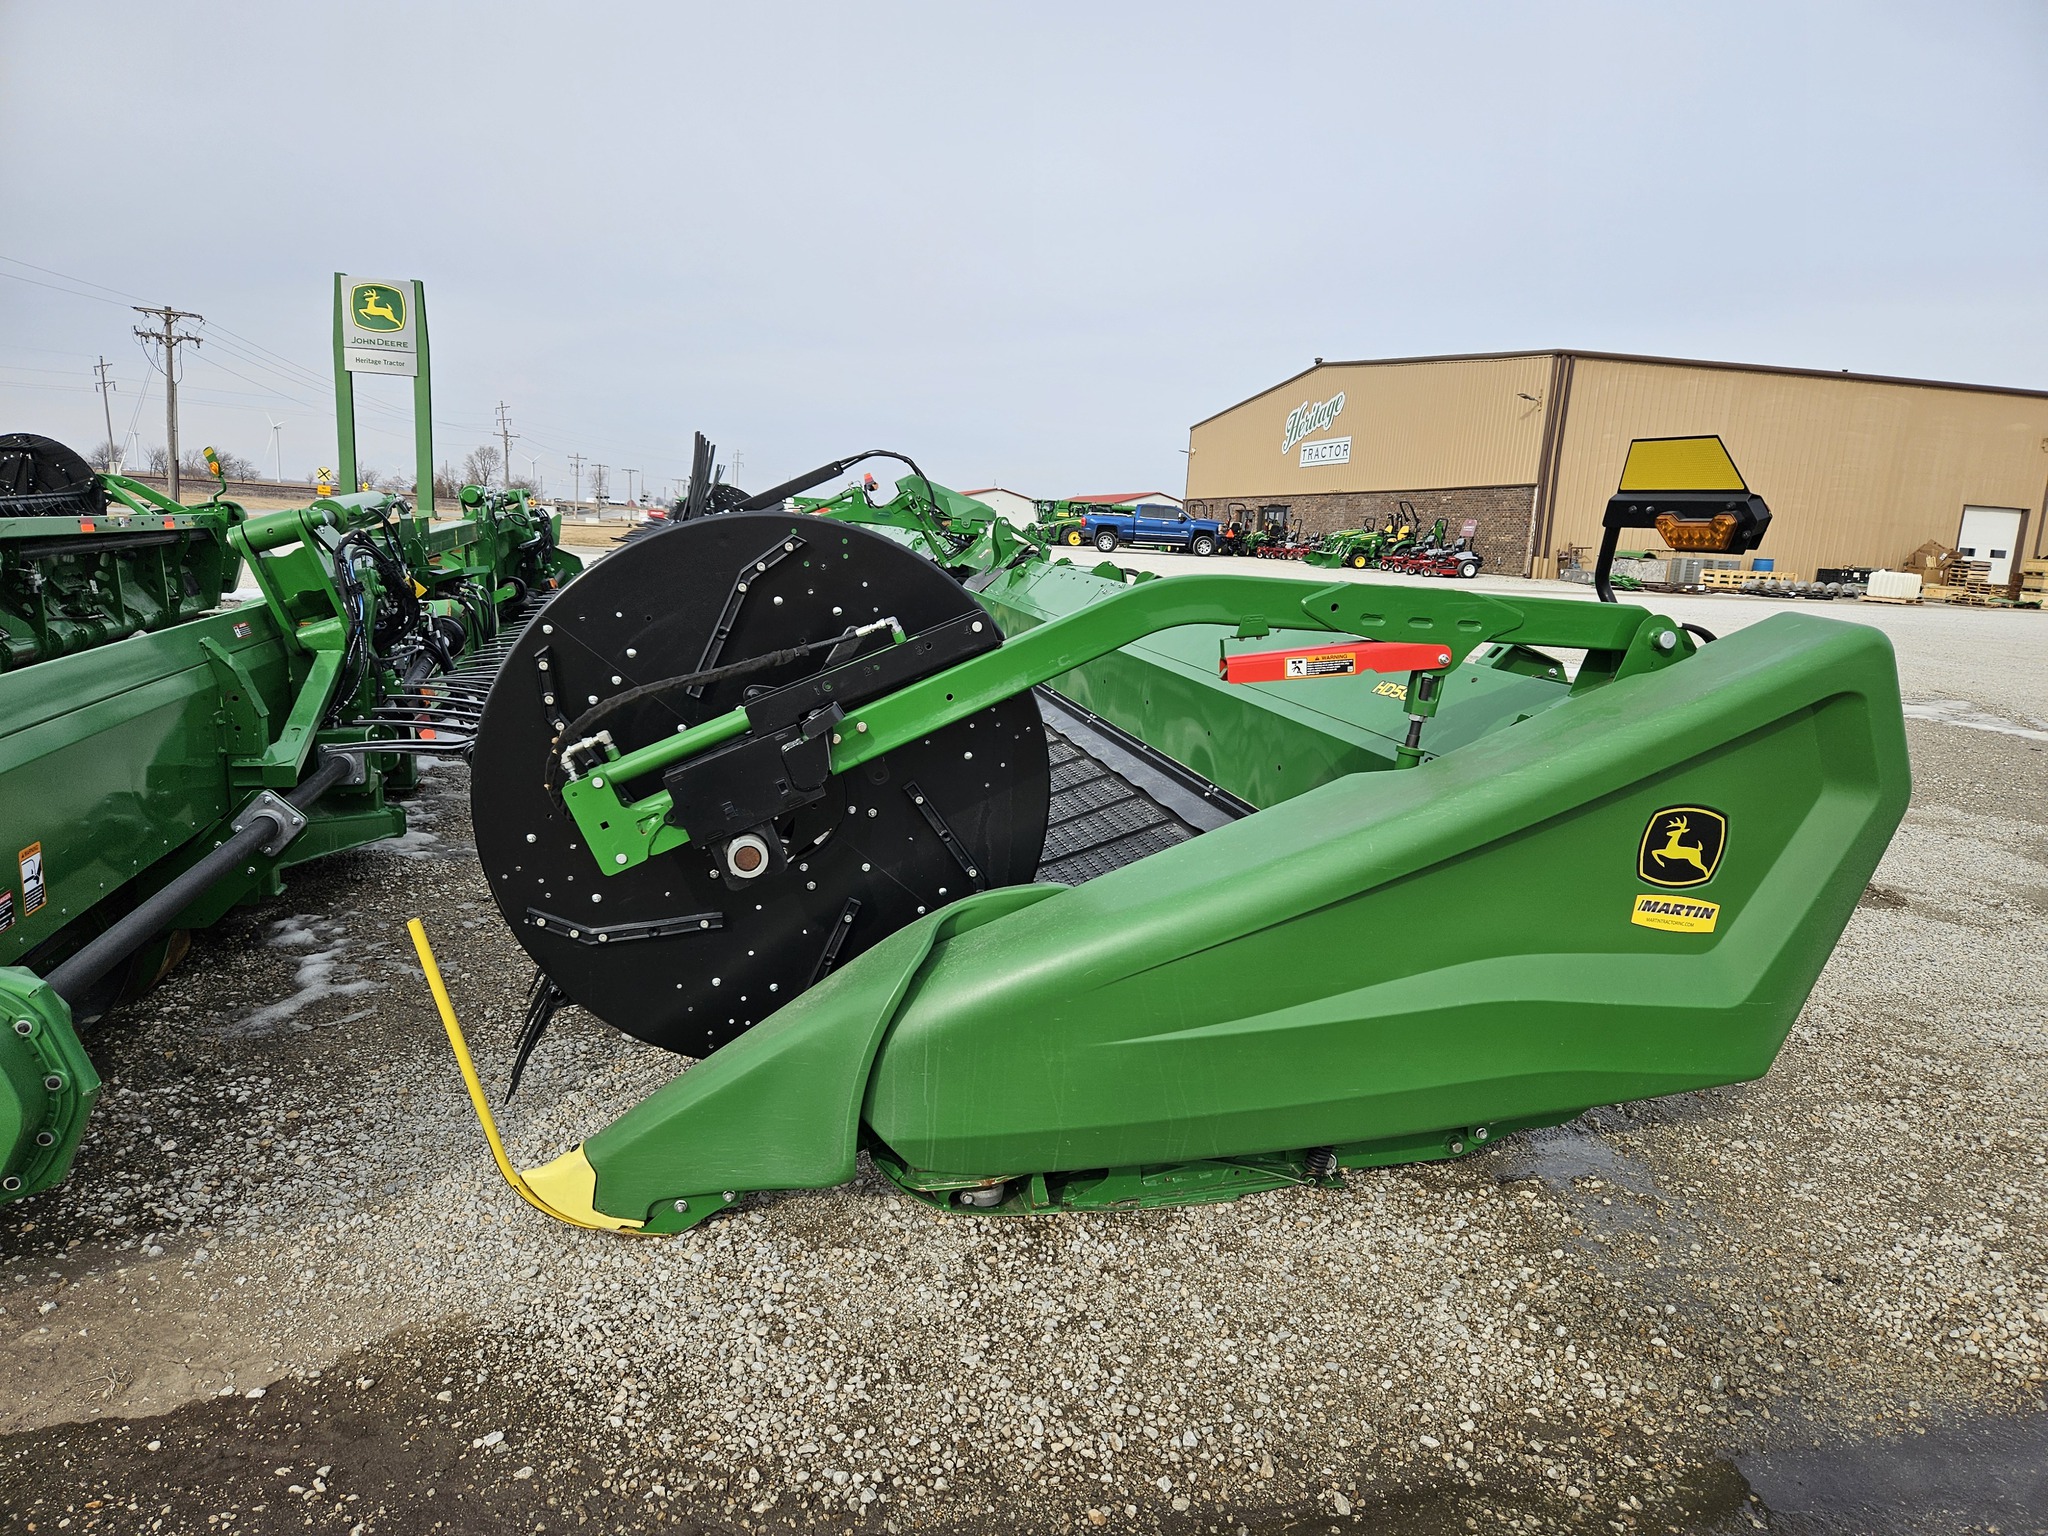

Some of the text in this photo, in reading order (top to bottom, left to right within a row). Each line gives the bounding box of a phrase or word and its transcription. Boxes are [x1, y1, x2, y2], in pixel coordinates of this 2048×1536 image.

[351, 336, 409, 348] JOHN DEERE
[355, 357, 405, 367] Heritage Tractor
[1283, 394, 1344, 451] Heritage
[1302, 443, 1349, 461] TRACTOR
[1641, 899, 1716, 920] MARTIN
